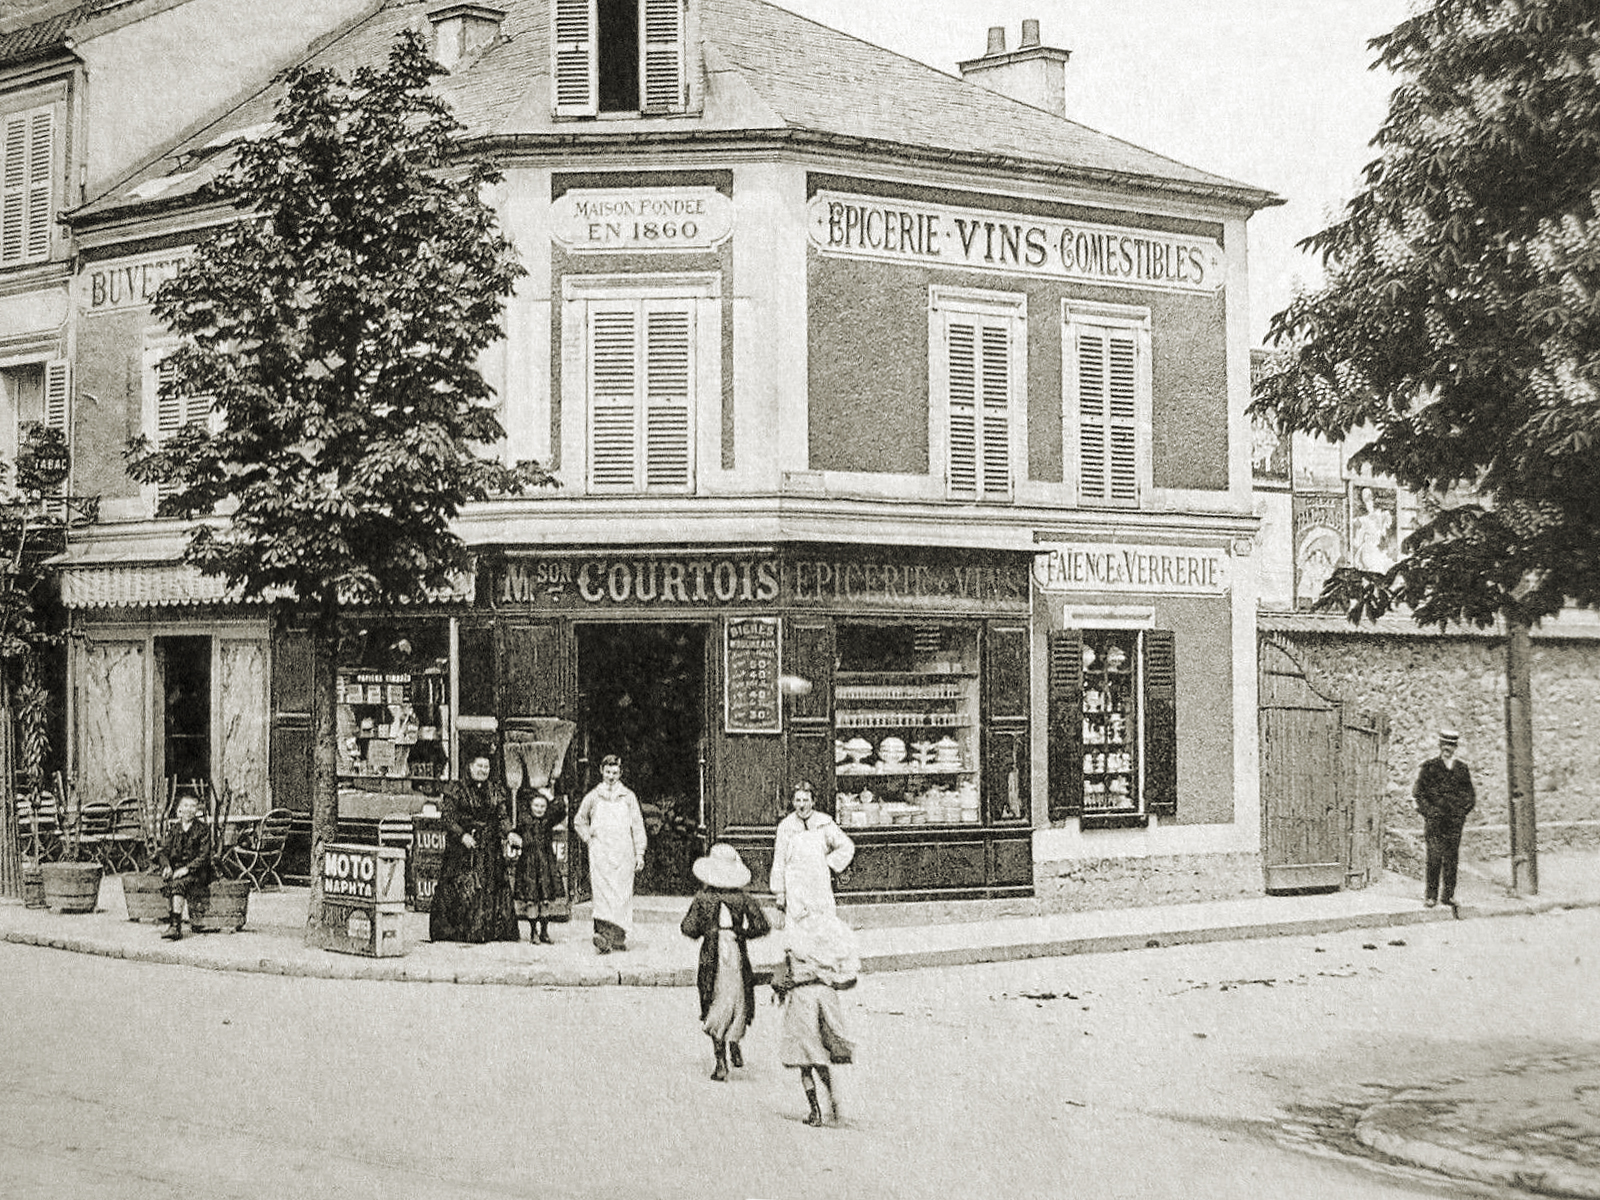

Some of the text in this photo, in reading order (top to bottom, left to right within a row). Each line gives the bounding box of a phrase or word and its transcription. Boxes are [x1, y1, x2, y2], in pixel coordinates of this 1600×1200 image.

[574, 200, 634, 219] MAISON
[588, 221, 698, 242] EN 1860
[828, 201, 1204, 285] EPICERIE VINS COMESTIBLES
[91, 258, 186, 307] BUVETT
[576, 560, 779, 602] COURTOIS
[1123, 550, 1219, 587] VERRERIE
[324, 852, 374, 881] MOTO
[324, 878, 373, 897] NAPHTA
